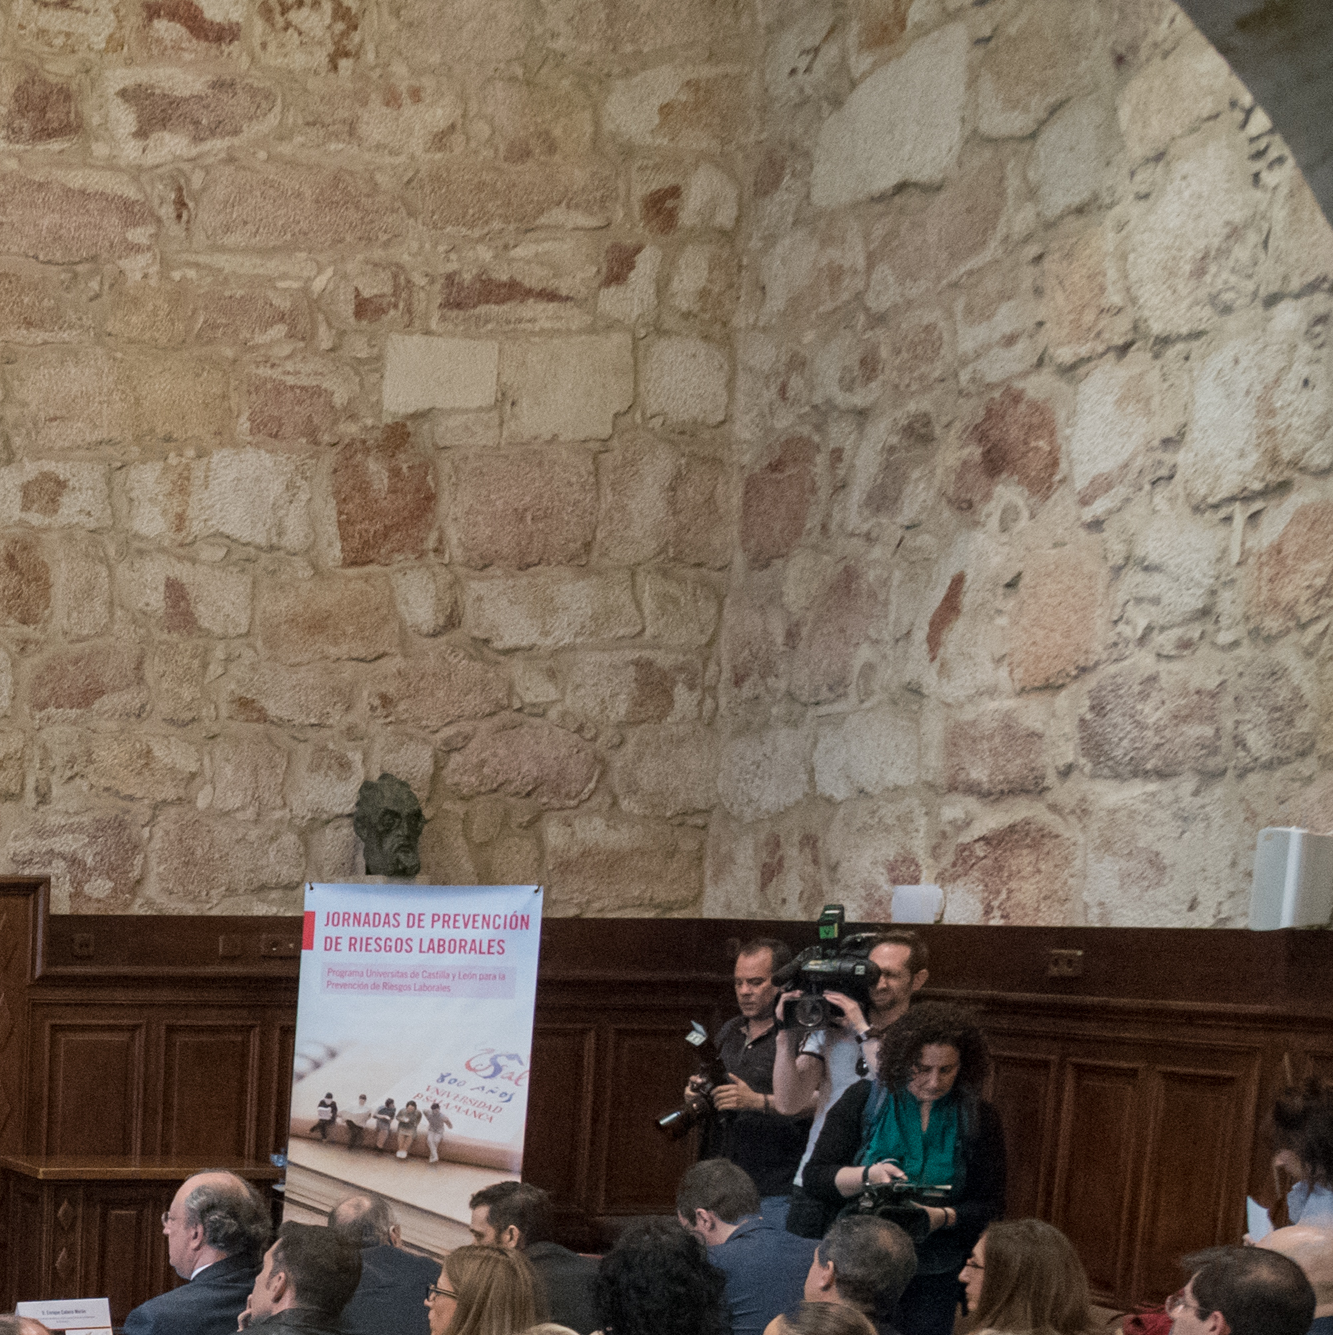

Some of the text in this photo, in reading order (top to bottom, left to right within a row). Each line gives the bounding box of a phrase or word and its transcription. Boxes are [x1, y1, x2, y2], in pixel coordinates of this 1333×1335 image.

[324, 910, 531, 931] JORNADAS DE PREVENCIÓN
[324, 936, 506, 956] DE RIESGOS LABORALES
[327, 968, 506, 983] Programa Universitas de Castilla y León para la
[326, 980, 451, 993] Prevención de Riesgos Laborales
